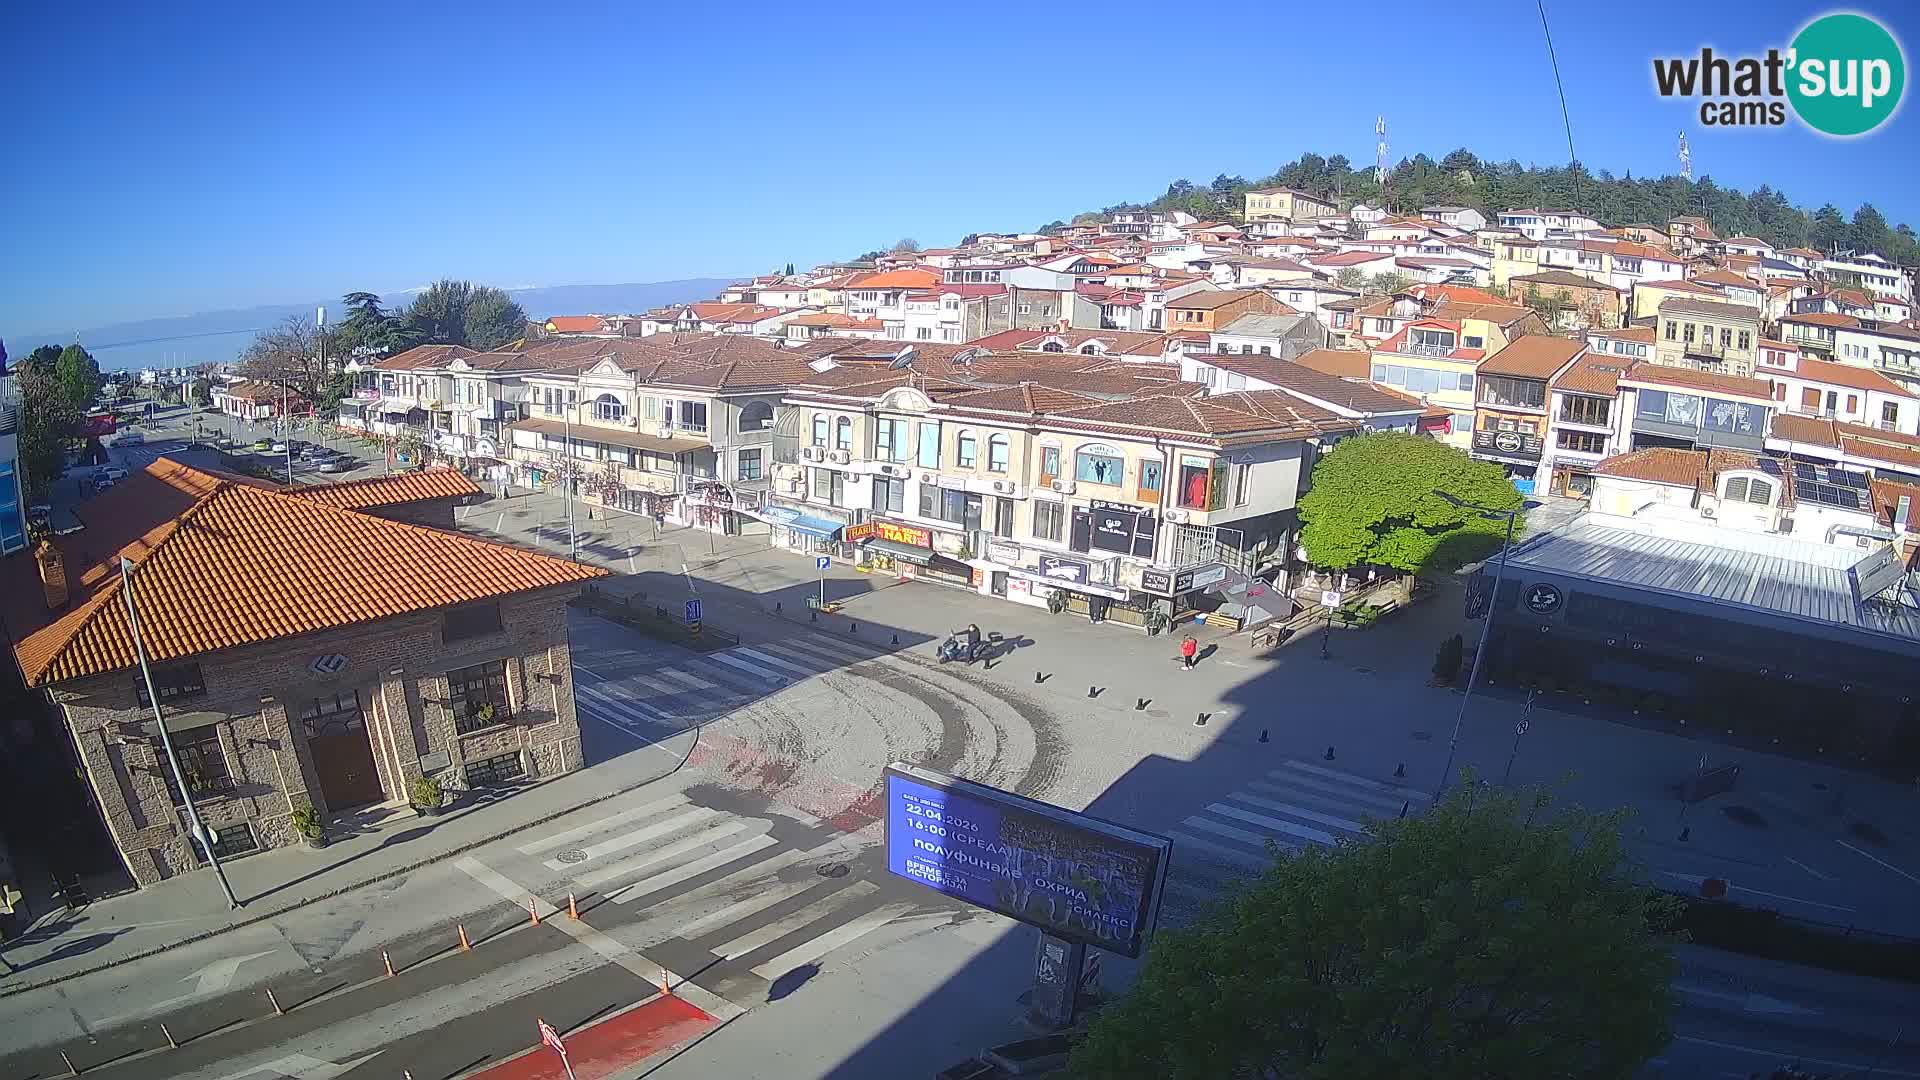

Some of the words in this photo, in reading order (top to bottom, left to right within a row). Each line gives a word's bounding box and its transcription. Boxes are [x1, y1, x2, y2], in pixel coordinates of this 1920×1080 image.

[905, 803, 979, 832] 22.04.2026
[906, 818, 947, 837] 16:00
[906, 859, 942, 877] ВРЕМЕ
[914, 838, 1022, 879] полуфинале
[1035, 878, 1087, 903] ОХРИД
[1073, 906, 1129, 927] СИЛЕКС
